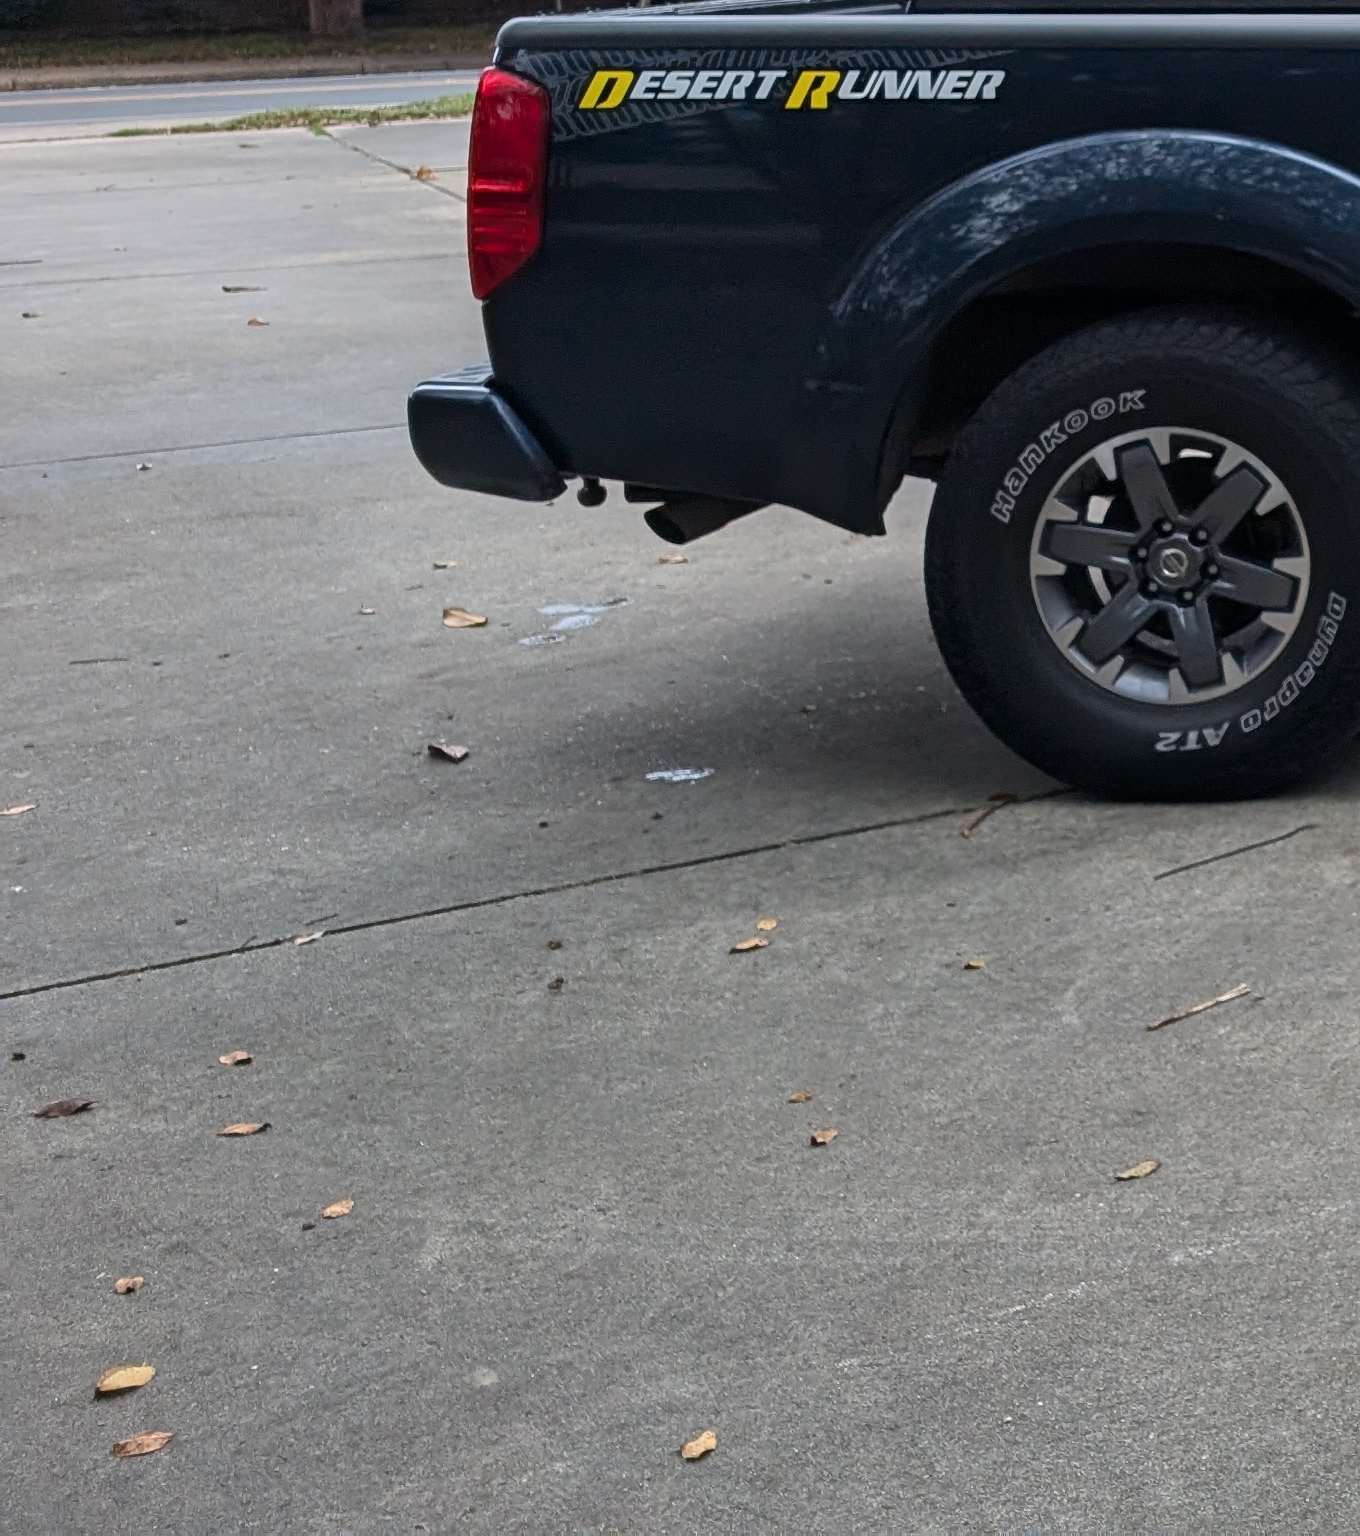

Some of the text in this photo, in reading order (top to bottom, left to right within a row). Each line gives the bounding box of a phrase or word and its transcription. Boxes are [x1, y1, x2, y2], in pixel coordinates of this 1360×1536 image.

[578, 69, 1007, 110] DESERT RUNNER
[1154, 590, 1348, 753] Dynapro AT2
